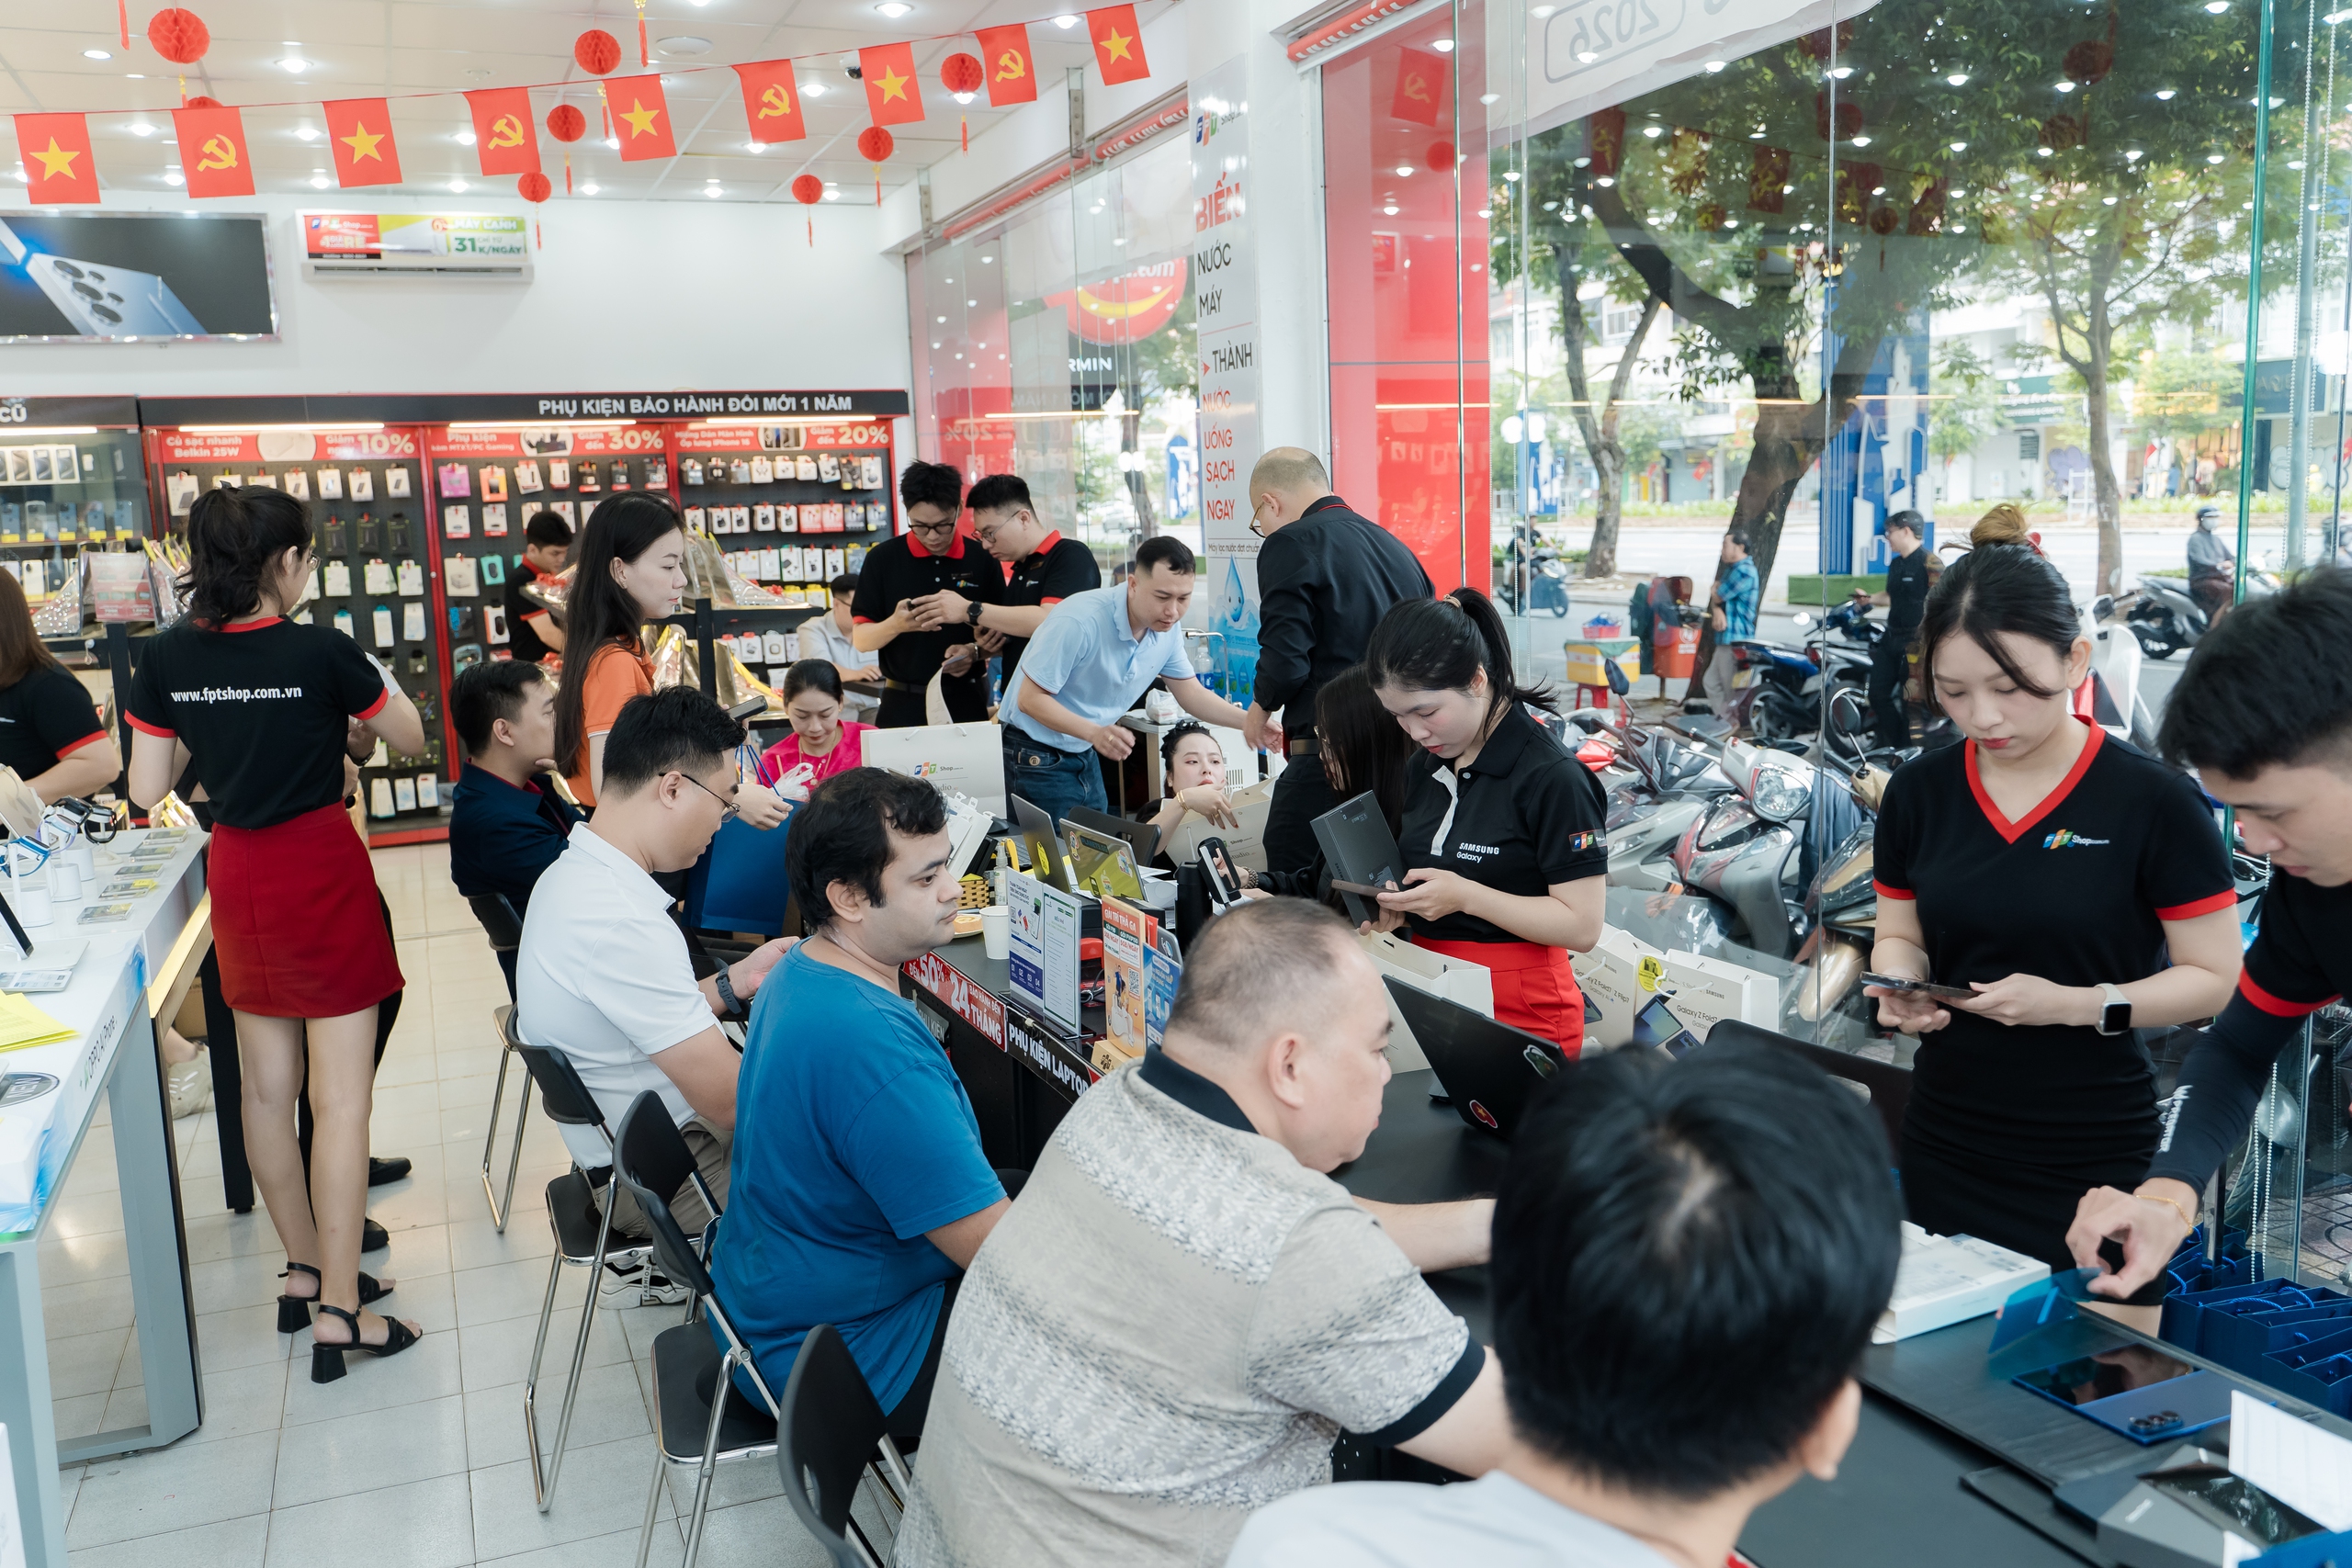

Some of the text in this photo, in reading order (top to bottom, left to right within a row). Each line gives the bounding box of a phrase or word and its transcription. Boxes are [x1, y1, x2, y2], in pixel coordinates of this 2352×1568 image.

[1196, 110, 1218, 146] FPT
[1196, 171, 1241, 233] BIẾN
[455, 236, 478, 253] 31
[1197, 239, 1232, 276] NƯỚC
[1199, 284, 1223, 318] MÁY
[1212, 339, 1253, 374] THÀNH
[538, 393, 852, 417] PHỤ KIỆN BẢO HÀNH ĐỔI MỚI 1 NĂM
[1203, 386, 1231, 413] NƯỚC
[166, 435, 243, 447] Củ sạc nhanh
[325, 434, 355, 445] Giảm
[356, 434, 415, 455] 10%
[447, 432, 497, 445] Phụ kiện
[608, 429, 664, 450] 30%
[712, 437, 740, 447] iPhone
[838, 424, 889, 445] 20%
[1204, 422, 1233, 450] UỐNG
[174, 446, 240, 457] Belkin 25W
[1206, 459, 1236, 489] SẠCH
[1206, 499, 1236, 521] NGAY
[171, 686, 302, 704] www.fptshop.com.vn
[914, 761, 937, 777] FPT
[1458, 842, 1500, 855] SAMSUNG
[1574, 833, 1594, 850] FPT
[2042, 829, 2074, 850] FPT
[1456, 852, 1483, 863] Galaxy
[1128, 920, 1136, 933] GA
[919, 953, 945, 994] 50%
[949, 971, 970, 1020] 24
[1617, 992, 1630, 1003] Flip7
[1676, 1004, 1697, 1019] Galaxy
[1702, 1012, 1718, 1023] Fold7
[970, 1003, 1002, 1046] THÁNG
[1009, 1022, 1029, 1057] PHỤ
[1029, 1037, 1051, 1071] KIỆN
